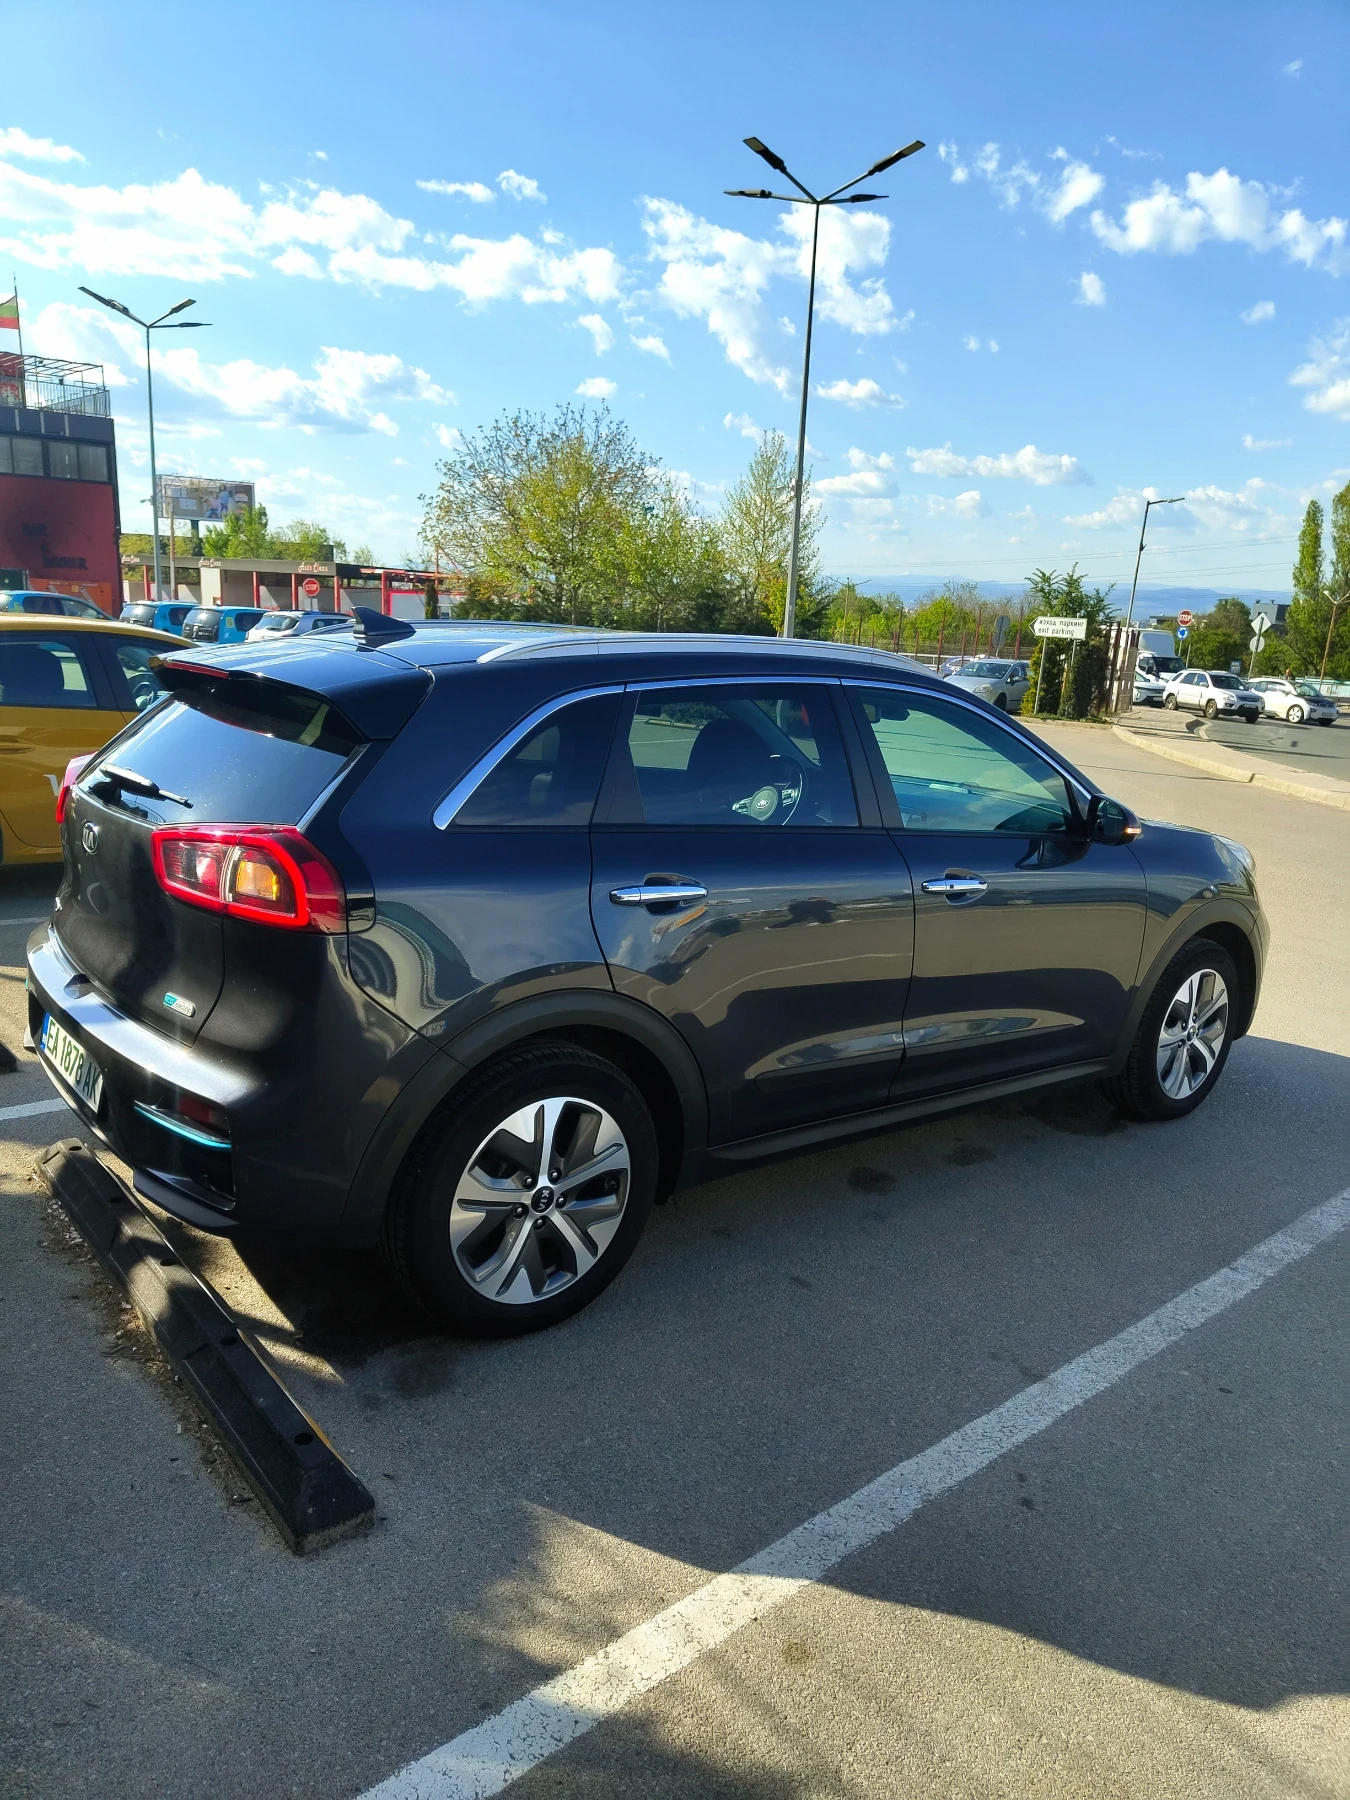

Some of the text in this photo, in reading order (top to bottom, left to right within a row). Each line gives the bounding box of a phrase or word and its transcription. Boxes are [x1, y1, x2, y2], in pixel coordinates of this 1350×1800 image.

[1060, 620, 1084, 628] паркинг
[1051, 628, 1075, 637] parking
[46, 1019, 60, 1060] EA
[82, 1061, 101, 1106] AK
[537, 1189, 550, 1211] KIA
